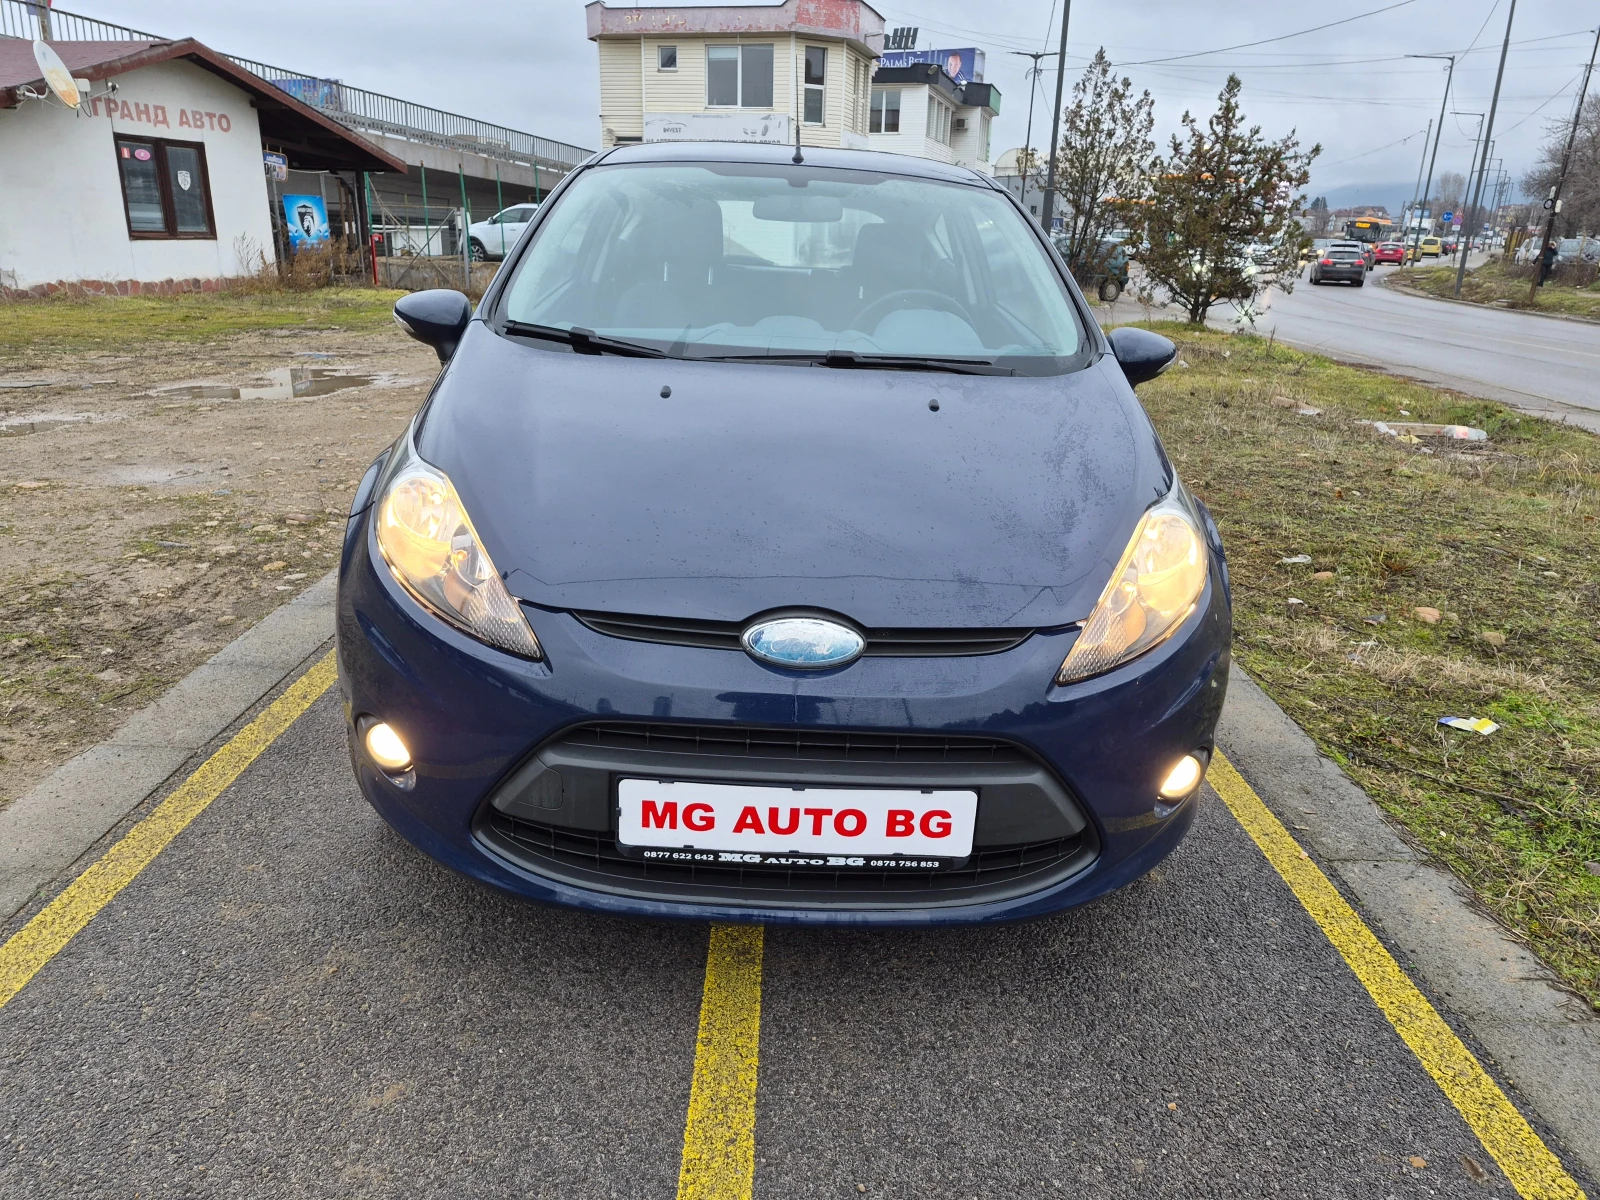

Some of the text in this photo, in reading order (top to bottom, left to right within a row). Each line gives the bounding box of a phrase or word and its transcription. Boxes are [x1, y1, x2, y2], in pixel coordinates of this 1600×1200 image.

[880, 57, 907, 67] PALMS
[90, 97, 231, 133] ГРАНД АВТО
[641, 800, 952, 838] MG AUTO BG
[643, 851, 670, 859] 0877
[672, 852, 692, 860] 622
[694, 853, 714, 861] 642
[718, 852, 763, 863] MG
[826, 857, 867, 866] BG
[870, 859, 896, 867] 0878
[899, 860, 918, 868] 756
